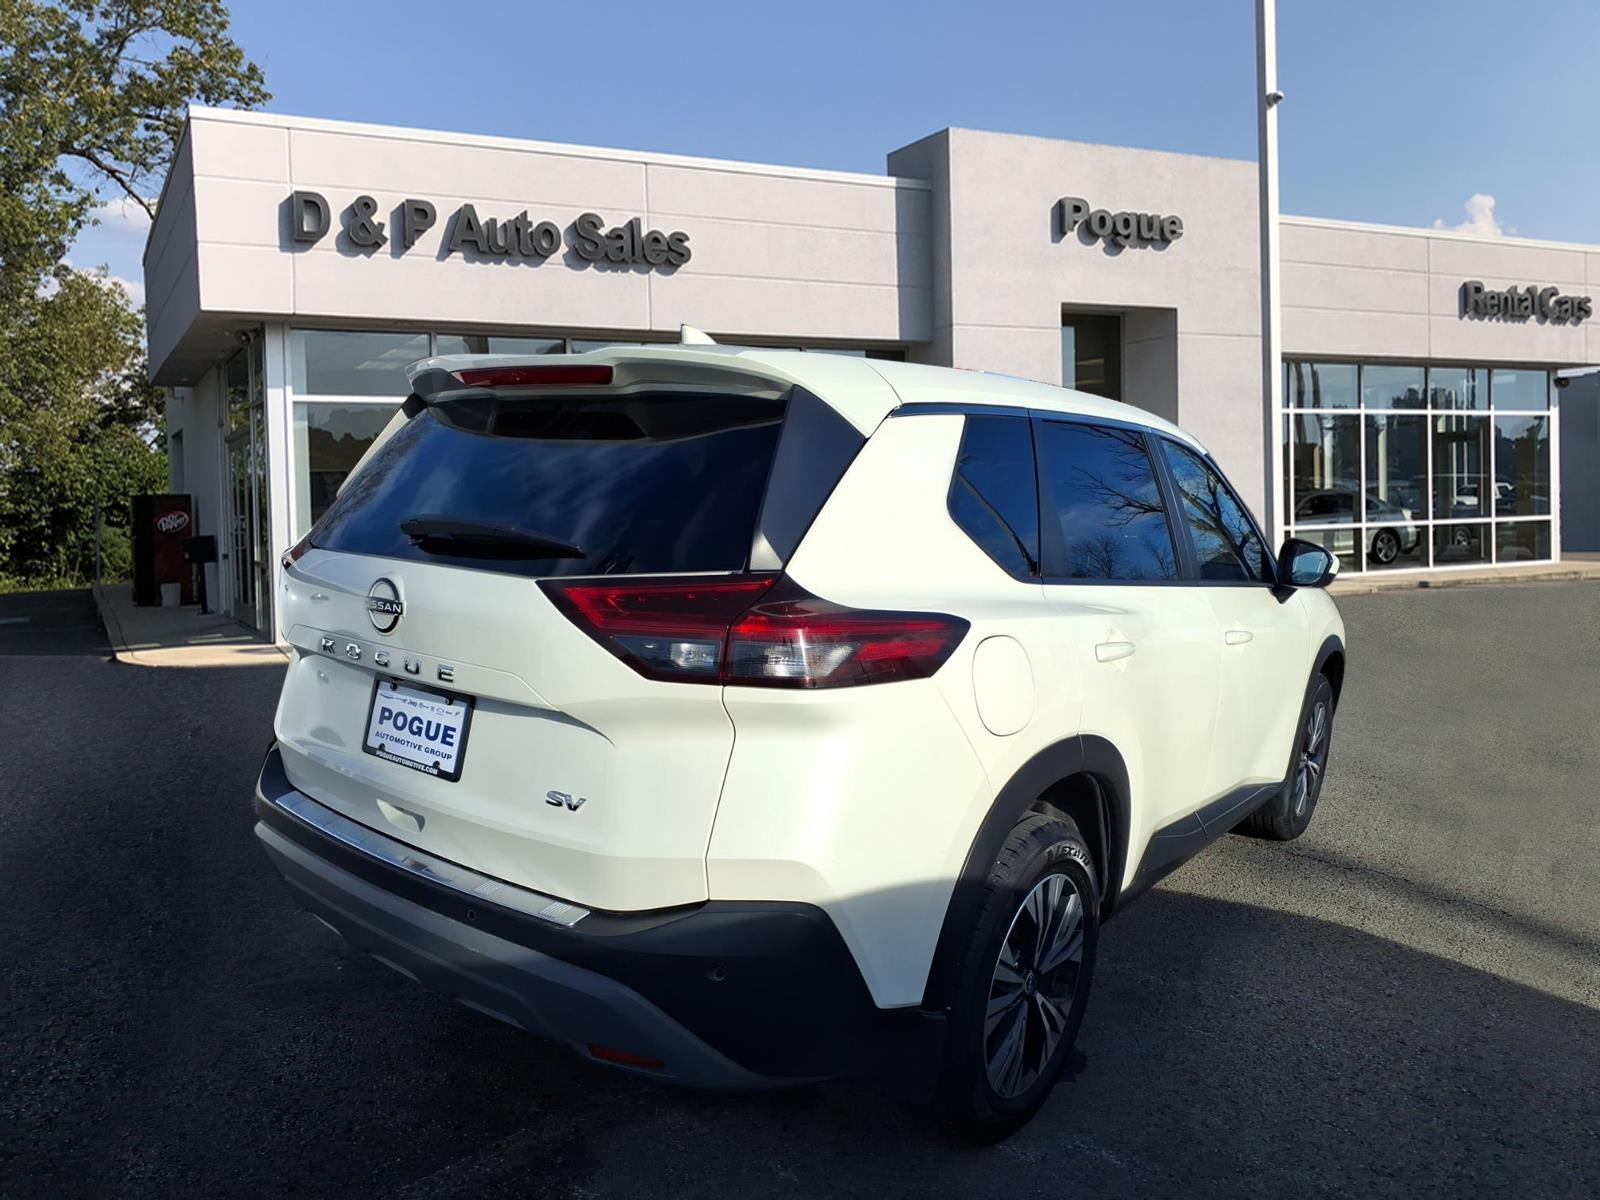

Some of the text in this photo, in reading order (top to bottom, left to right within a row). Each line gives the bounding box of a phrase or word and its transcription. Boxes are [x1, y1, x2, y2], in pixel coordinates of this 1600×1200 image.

[287, 190, 692, 268] D & P Auto Sales
[1058, 196, 1184, 250] Pogue
[1462, 280, 1592, 320] Rental Cars
[368, 600, 402, 613] SSAN
[320, 636, 455, 683] ROGUE
[374, 731, 453, 760] AUTOMOTIVE GROUP
[378, 705, 457, 747] POGUE
[545, 790, 587, 811] SV
